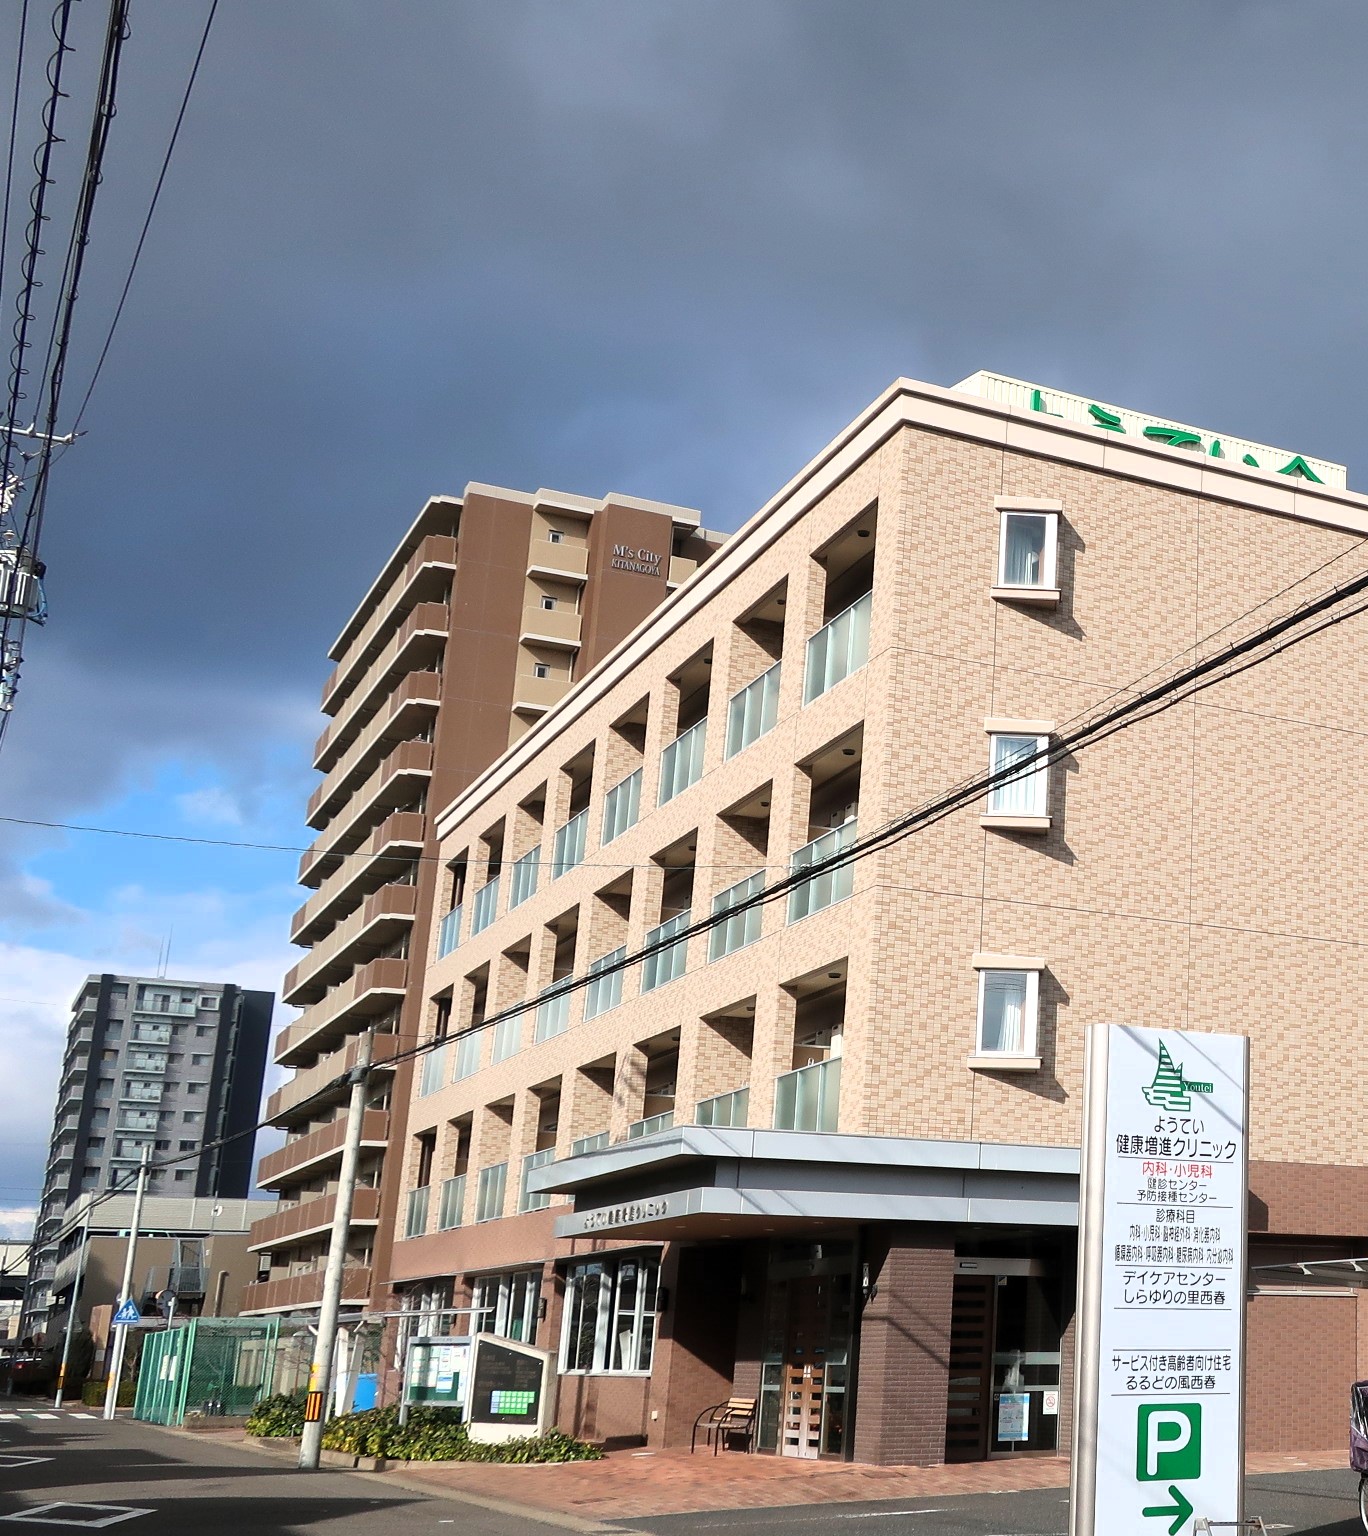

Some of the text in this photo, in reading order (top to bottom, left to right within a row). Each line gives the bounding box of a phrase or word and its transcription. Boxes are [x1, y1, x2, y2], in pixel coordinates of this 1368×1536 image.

[613, 544, 662, 566] M's City
[611, 558, 660, 576] KITANAGOYA
[1183, 1082, 1213, 1094] Youtei
[1154, 1116, 1205, 1135] ようてい
[1116, 1134, 1237, 1160] 健康増進クリニック
[1147, 1177, 1207, 1191] 健診センター
[1136, 1190, 1218, 1204] 予防接種センター
[1156, 1209, 1195, 1224] 診療科目
[1122, 1271, 1226, 1287] デイケアセンター
[1123, 1289, 1226, 1305] しらゆりの里西春
[1112, 1354, 1231, 1372] サービス付き高齢者向け住宅
[1126, 1375, 1216, 1391] るるどの風西春
[1147, 1410, 1192, 1476] P
